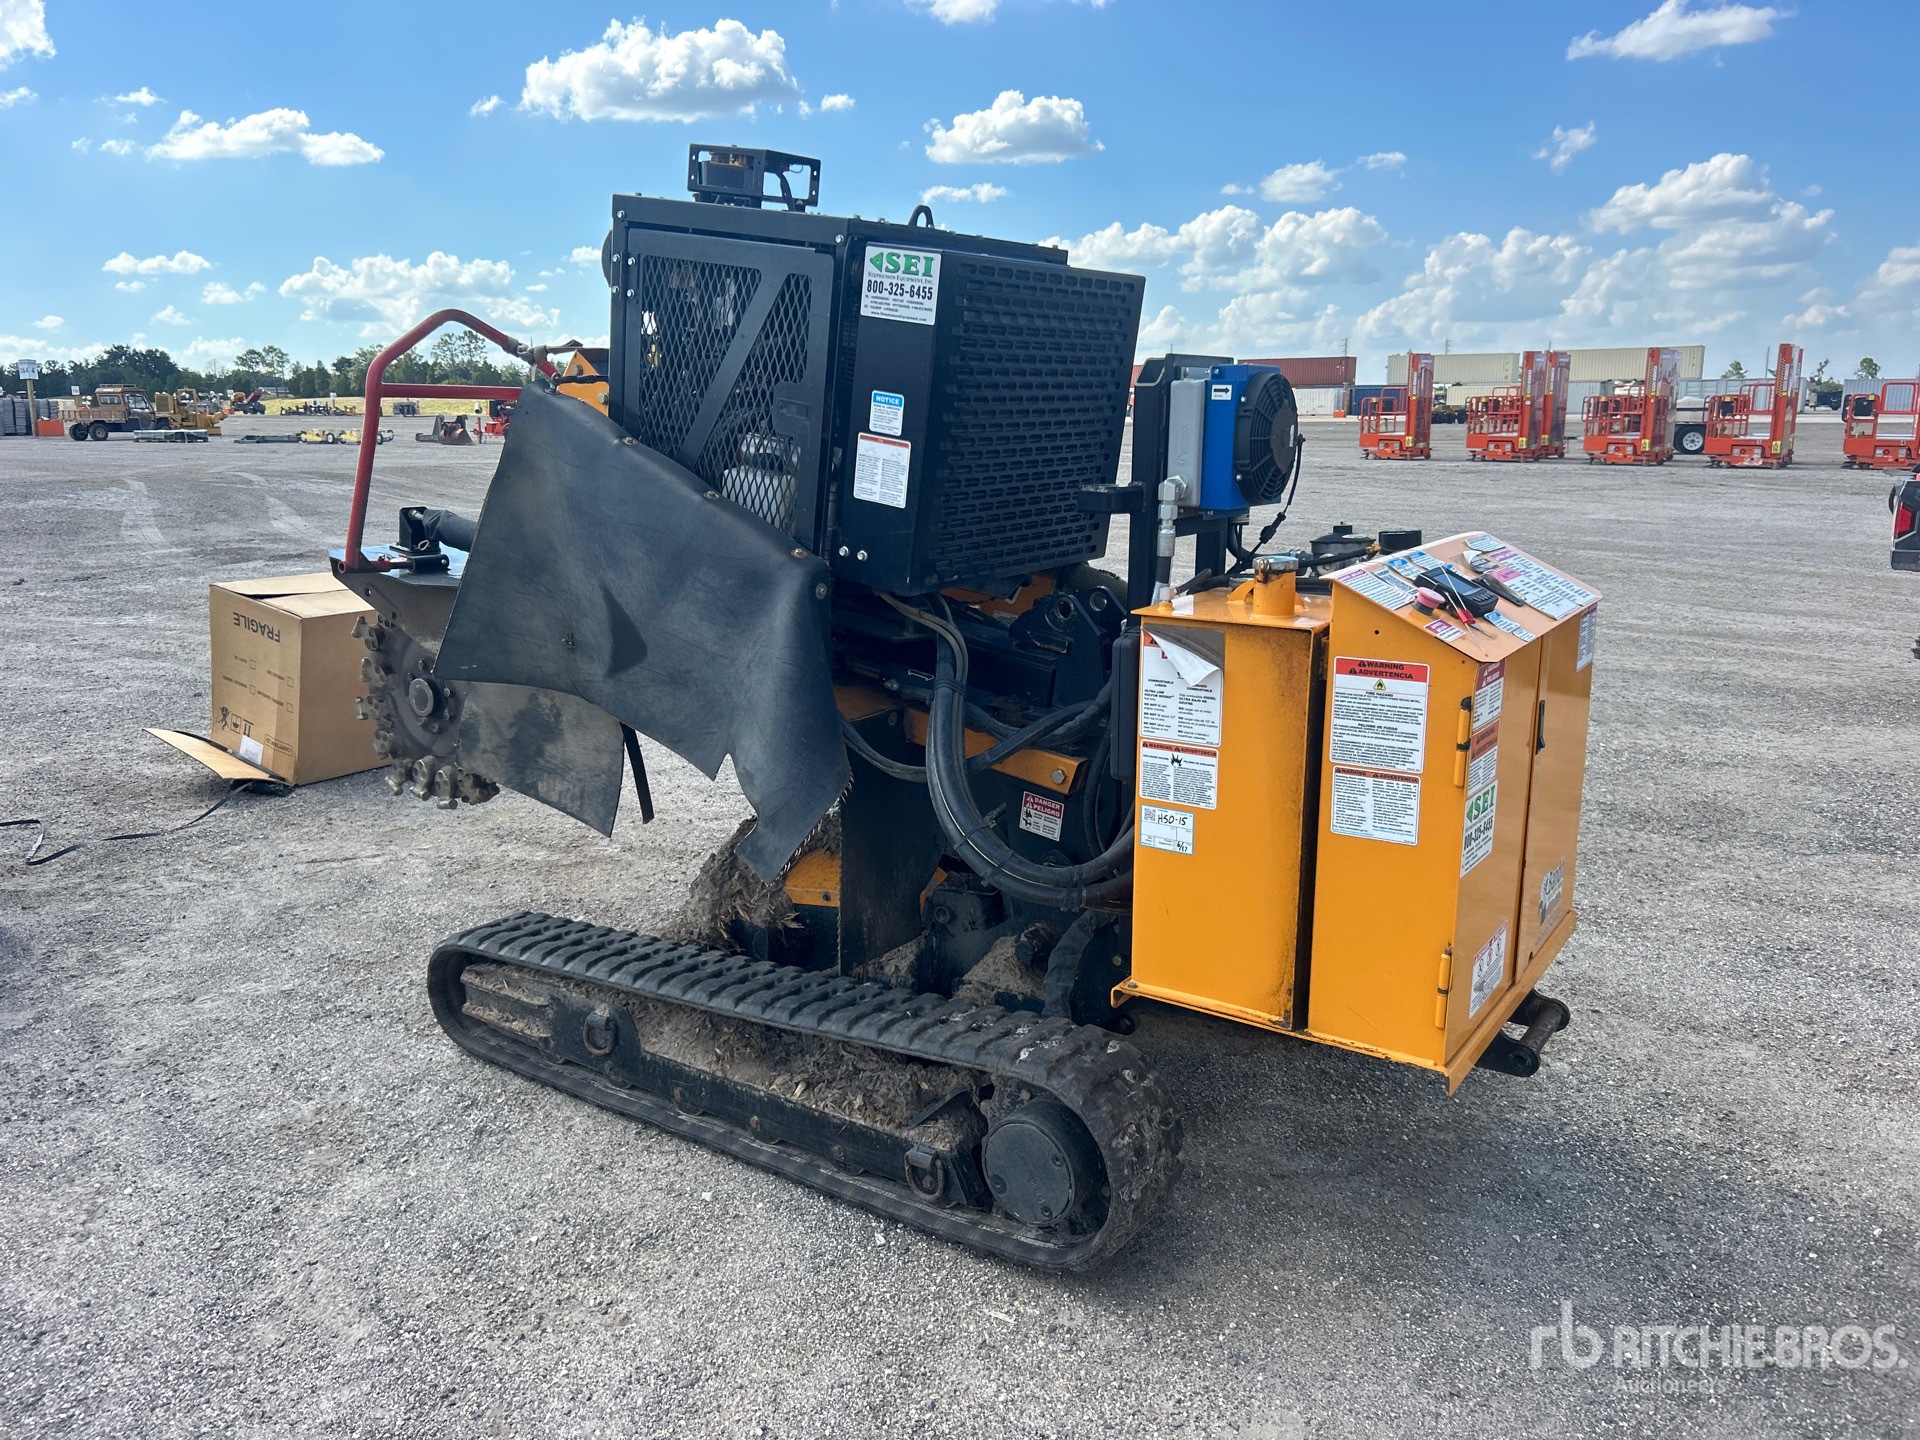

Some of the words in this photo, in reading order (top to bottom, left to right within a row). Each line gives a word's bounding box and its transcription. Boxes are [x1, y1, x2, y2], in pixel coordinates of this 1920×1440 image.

[885, 252, 935, 277] SEI
[867, 279, 933, 300] 800-325-6455
[876, 395, 899, 405] NOTICE
[233, 612, 280, 643] FRAGILE
[1367, 661, 1404, 670] WARNING
[1358, 669, 1413, 679] ADVERTENCIA
[1181, 748, 1216, 757] ADVERTENCIA
[1380, 774, 1418, 783] ADVERTENCIA
[1035, 797, 1060, 810] DANGER
[1473, 785, 1495, 820] SEI
[1033, 804, 1060, 817] PELIGRO
